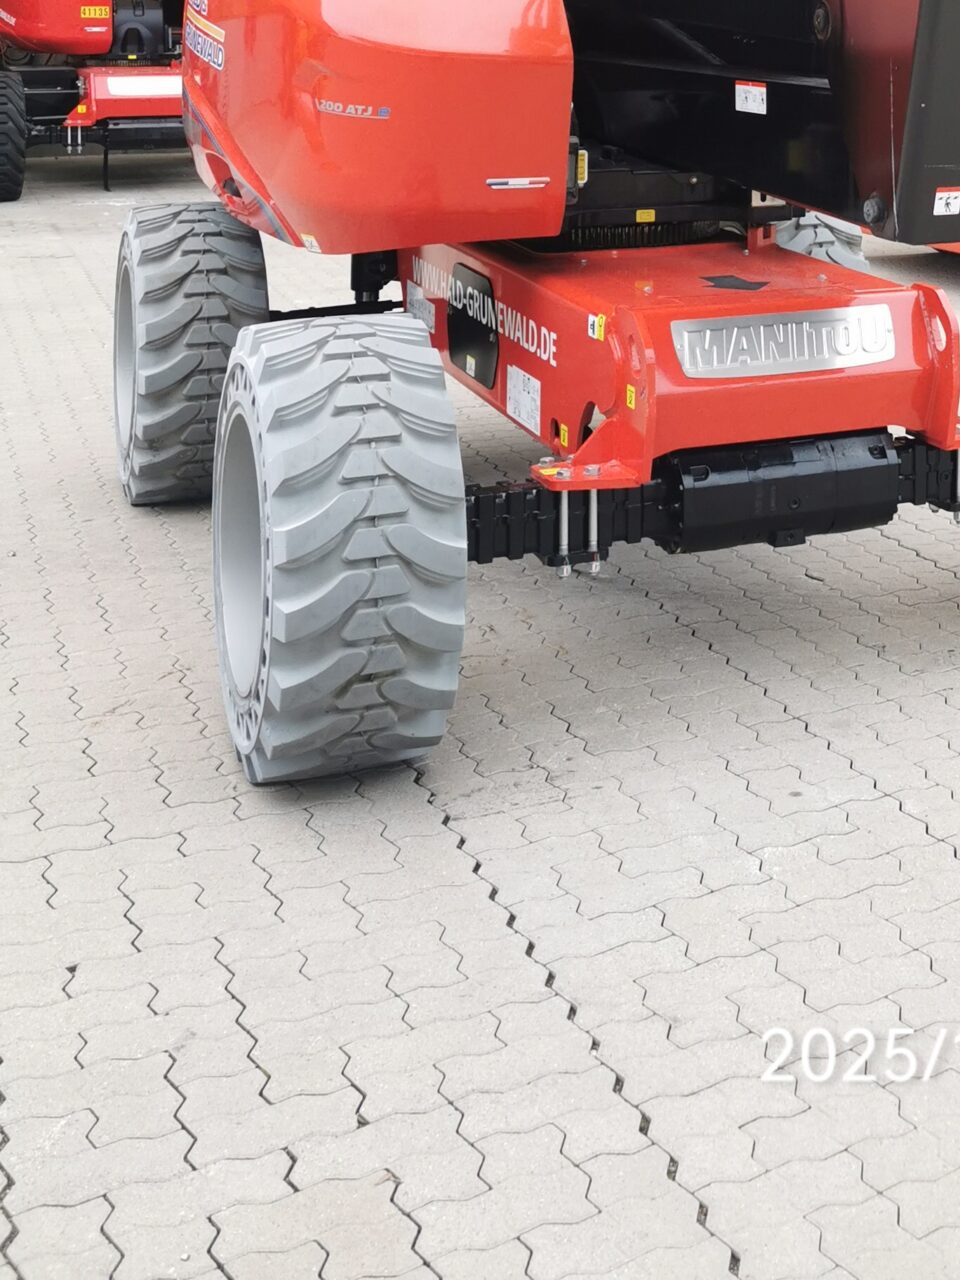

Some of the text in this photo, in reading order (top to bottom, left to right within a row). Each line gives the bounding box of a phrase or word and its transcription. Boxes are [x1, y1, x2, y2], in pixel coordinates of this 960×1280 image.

[81, 7, 109, 17] 41135
[319, 99, 344, 113] 200
[345, 104, 373, 116] ATJ
[412, 255, 558, 368] WWW.HALD-GRUNEWALD.DE
[683, 316, 888, 371] MANITOU
